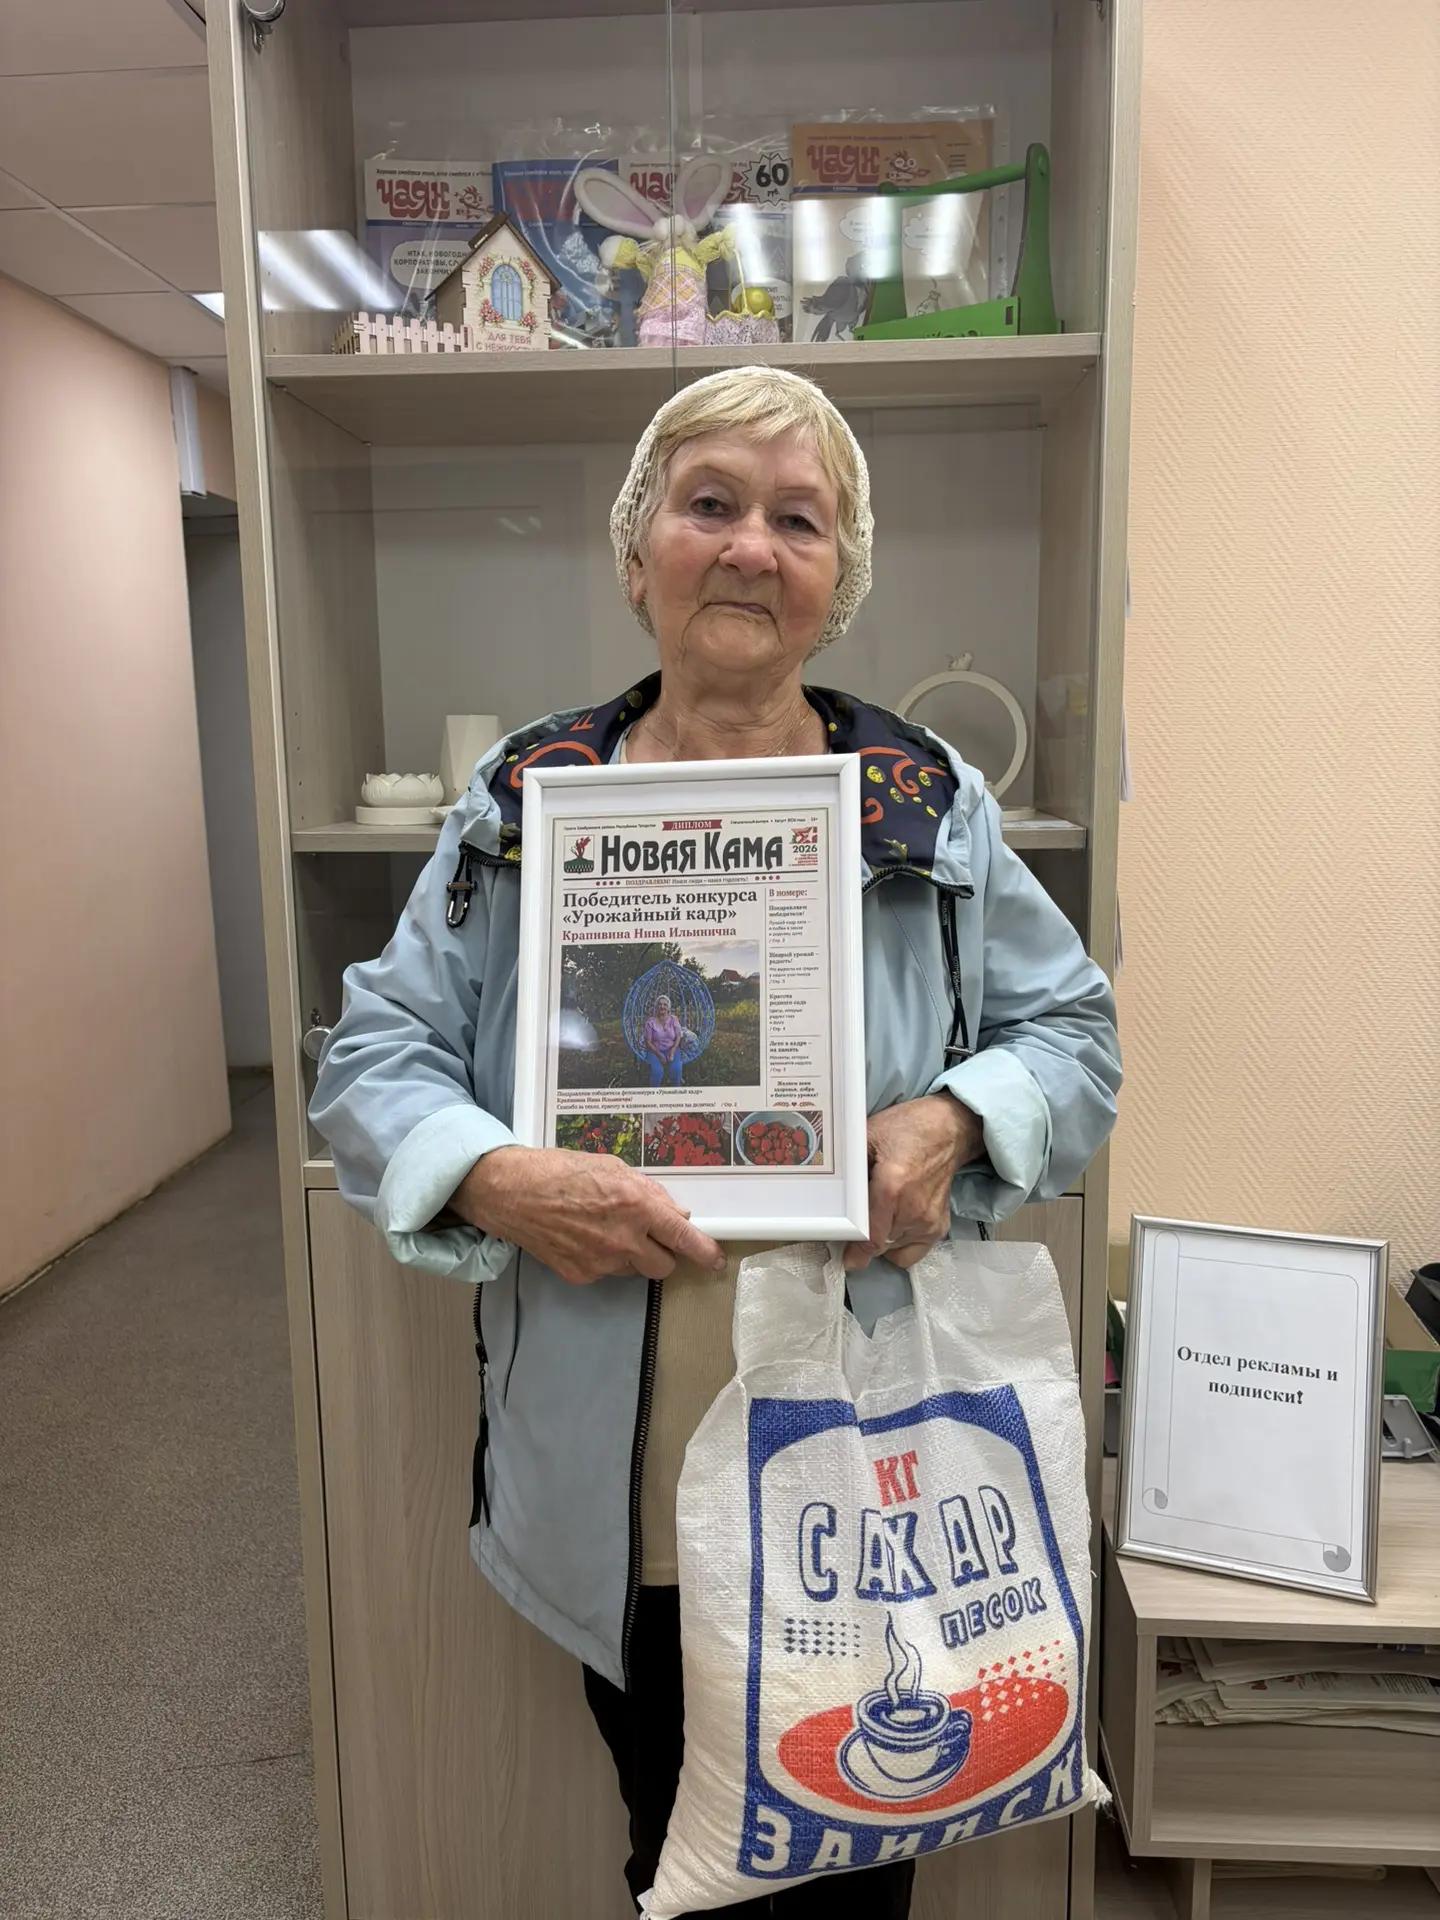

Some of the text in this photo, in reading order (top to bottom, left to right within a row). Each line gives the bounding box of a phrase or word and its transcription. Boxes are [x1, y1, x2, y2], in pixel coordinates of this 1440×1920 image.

[756, 163, 790, 188] 60
[671, 820, 712, 830] ДИПЛОМ
[793, 844, 818, 853] 2026
[563, 891, 757, 911] Победитель конкурса
[769, 889, 808, 898] В номере:
[563, 907, 737, 927] «Урожайный кадр»
[562, 927, 737, 942] Крапивина Нина Ильинична
[1177, 1346, 1338, 1381] Отдел рекламы и
[1209, 1381, 1303, 1405] подписки!
[873, 1450, 921, 1507] КГ
[939, 1577, 1047, 1649] ПЕСОК
